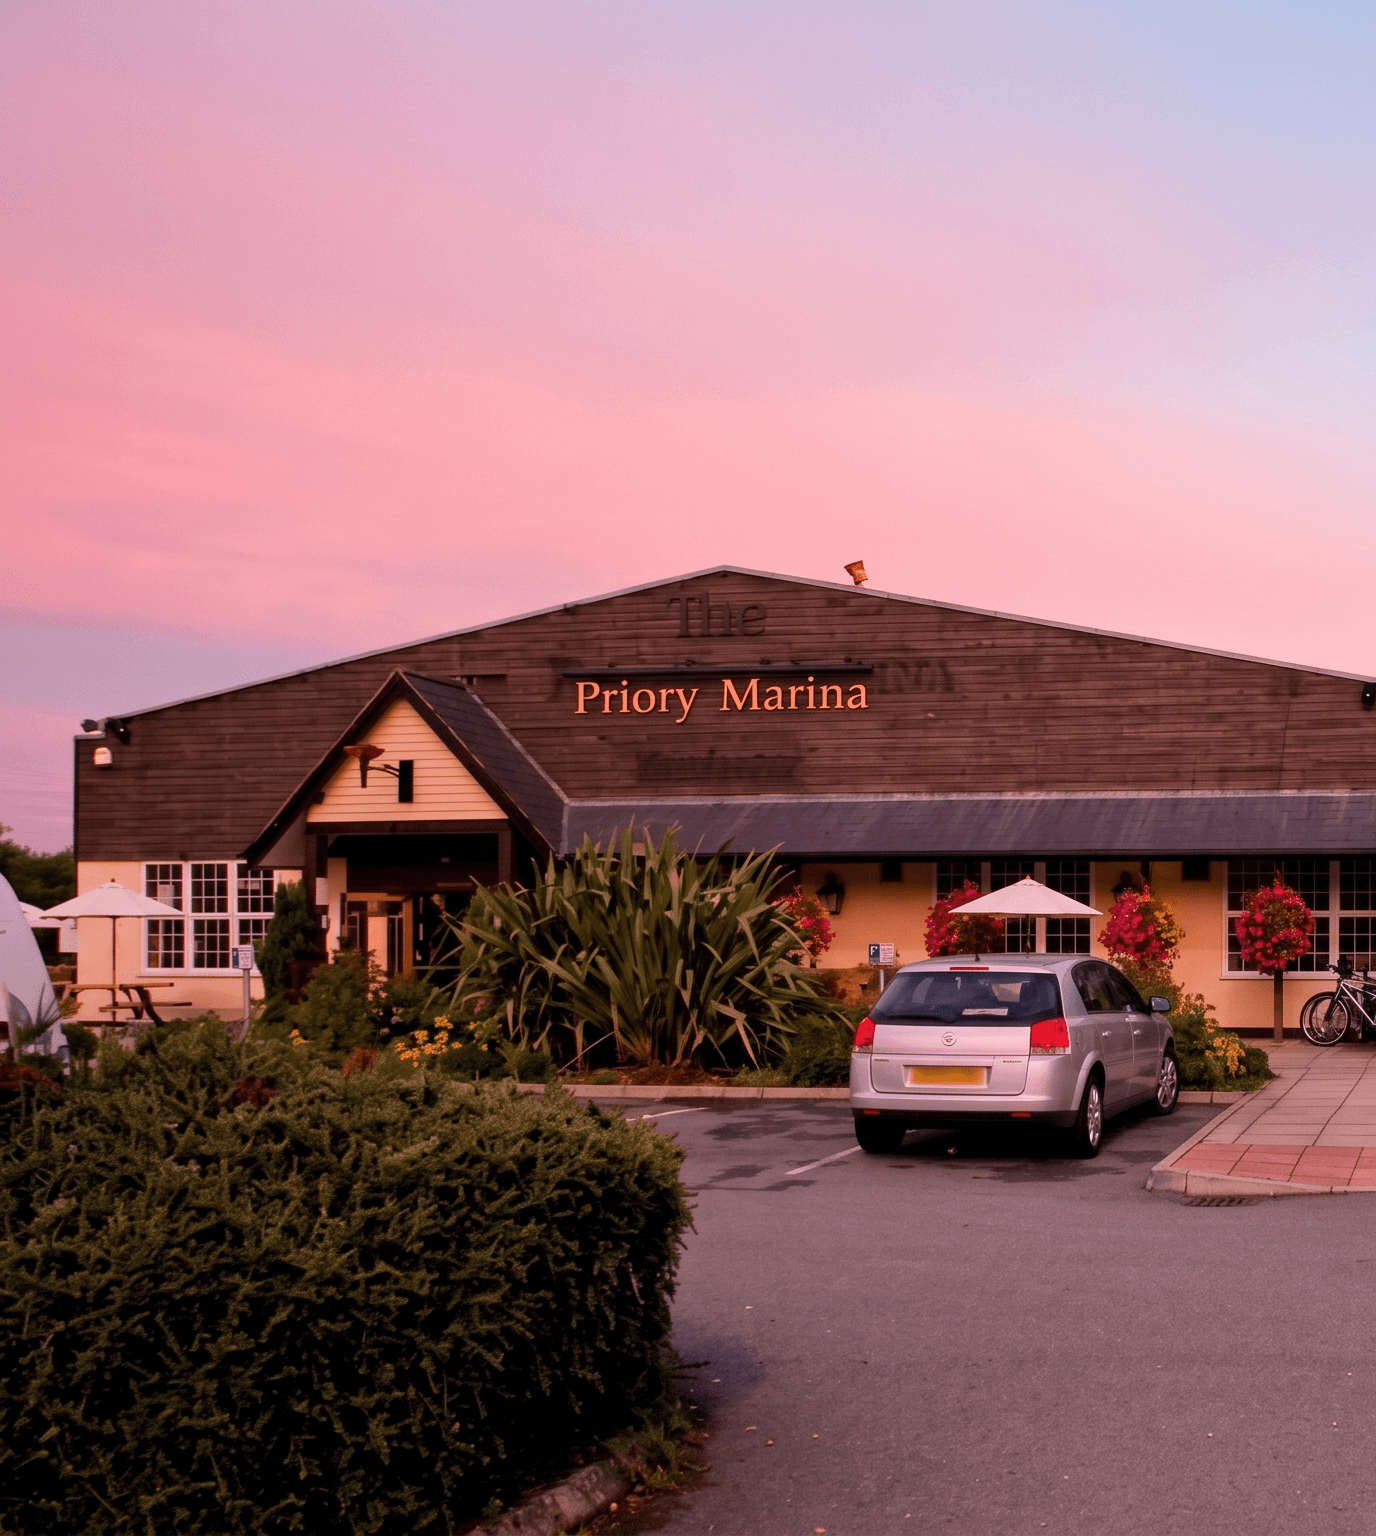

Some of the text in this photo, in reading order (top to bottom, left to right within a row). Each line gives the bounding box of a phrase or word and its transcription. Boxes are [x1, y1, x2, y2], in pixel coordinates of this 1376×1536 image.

[667, 591, 767, 638] The
[574, 676, 869, 724] Priory Marina
